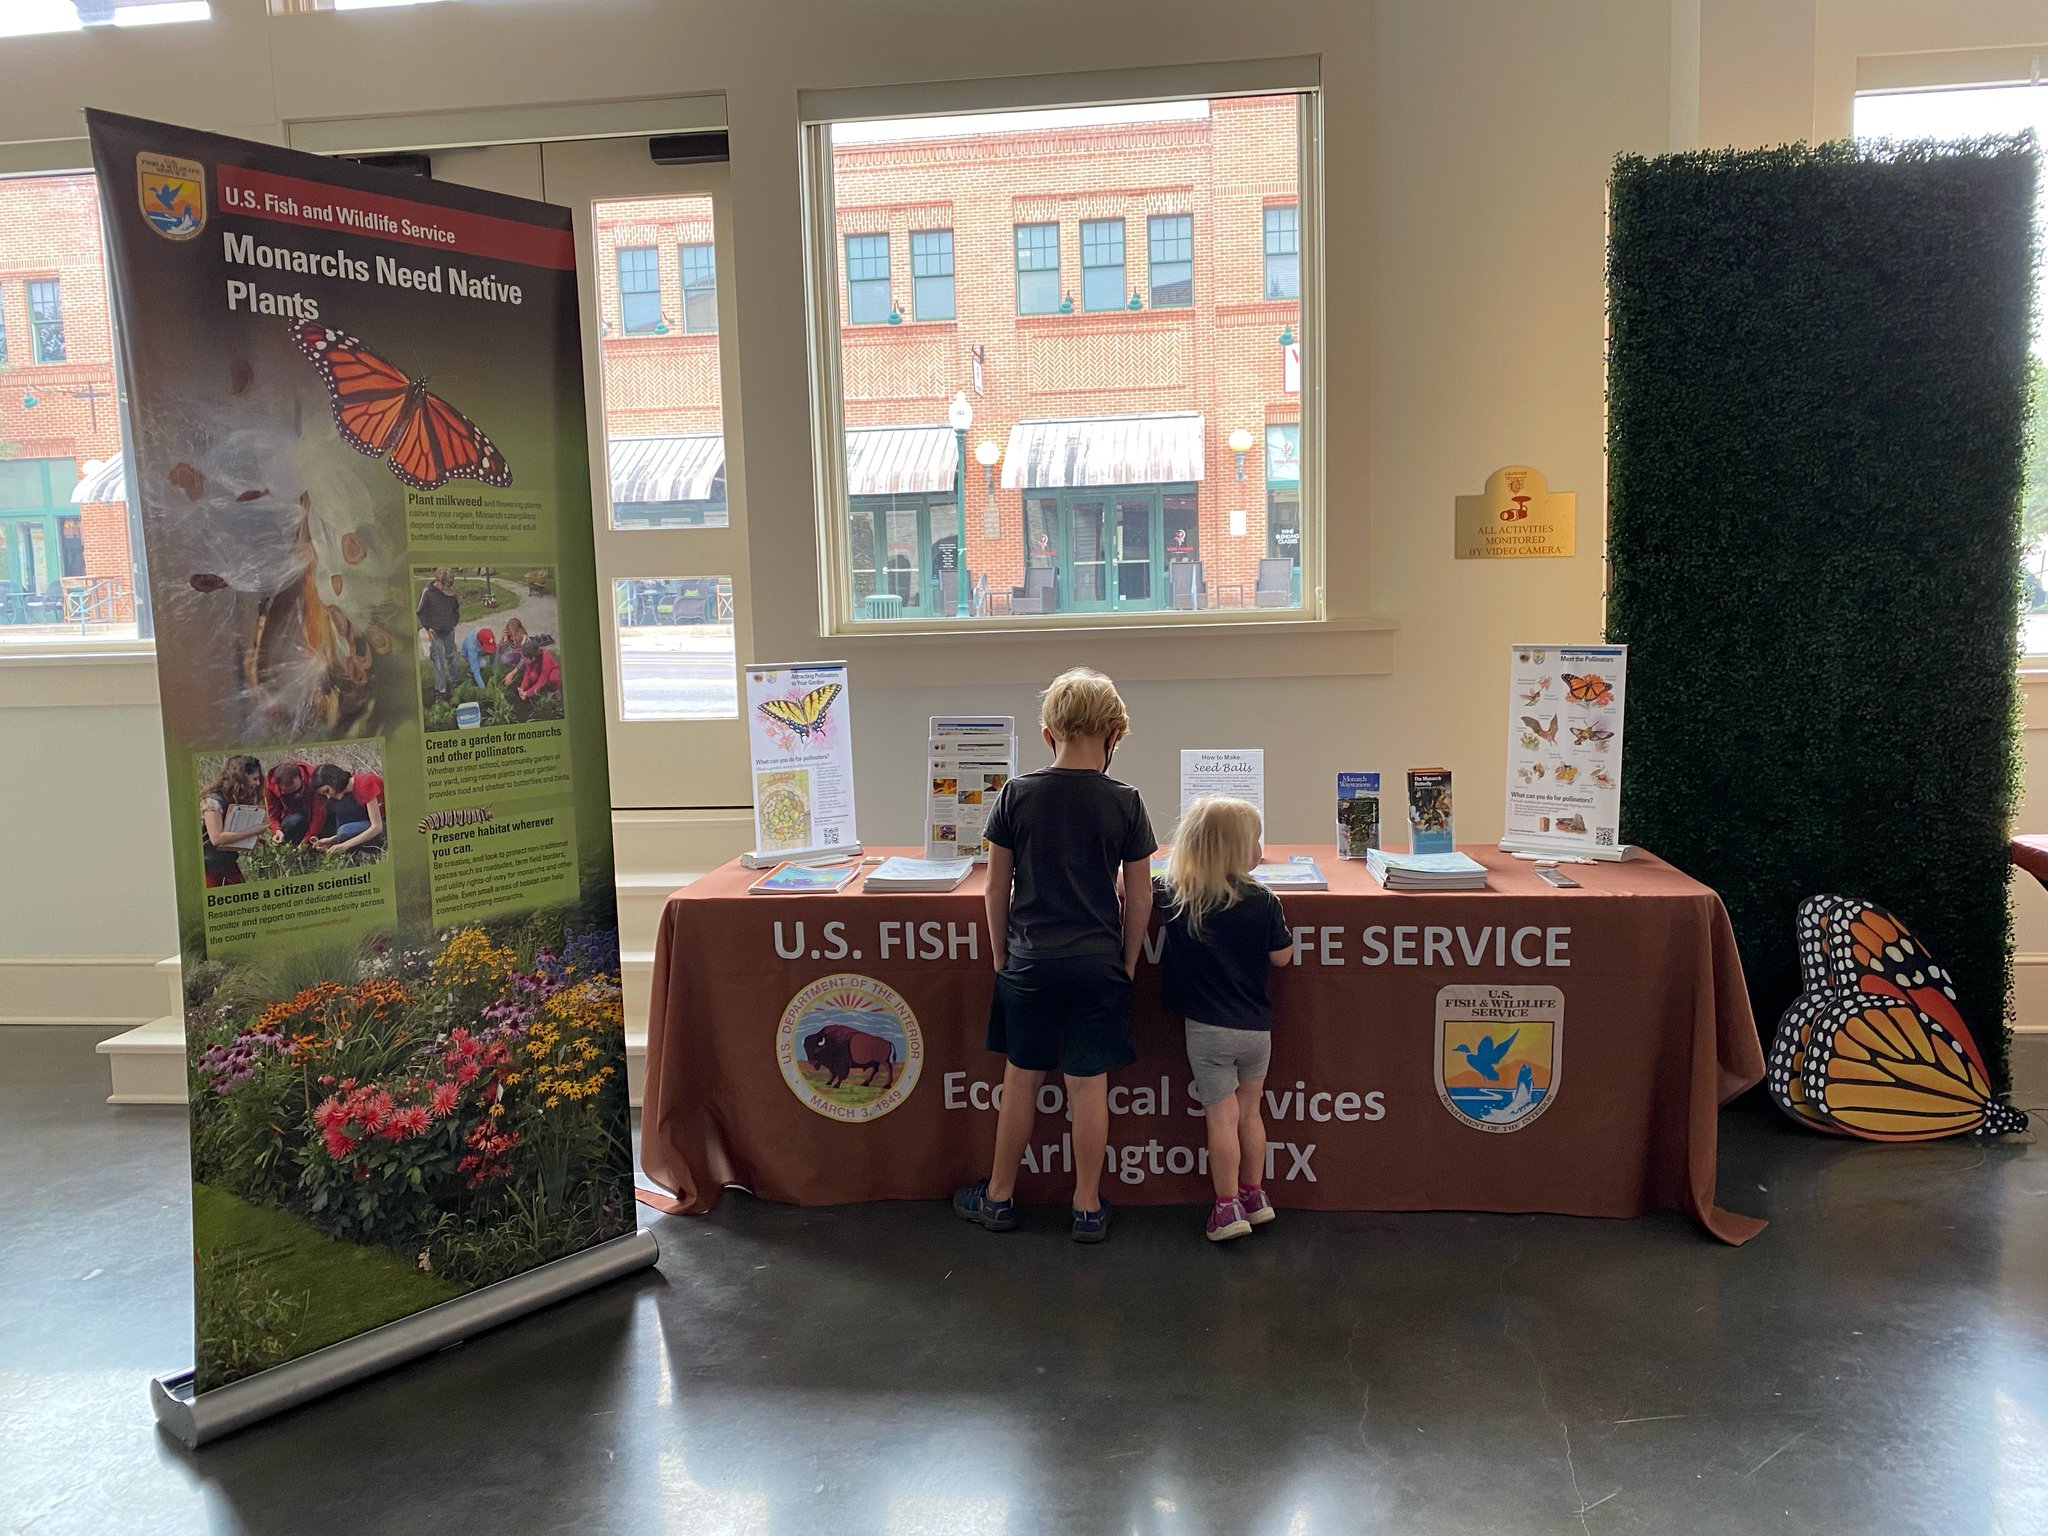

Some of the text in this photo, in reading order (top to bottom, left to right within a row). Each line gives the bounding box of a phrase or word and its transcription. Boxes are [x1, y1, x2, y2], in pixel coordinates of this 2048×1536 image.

[225, 186, 456, 244] U.S. Fish and Wildlife Service
[223, 231, 522, 305] Monarchs Need Native
[227, 279, 319, 320] Plants
[409, 493, 482, 507] Plant milkweed
[1477, 525, 1554, 535] ALL ACTIVITIES
[1486, 536, 1545, 545] MONITORED
[1469, 546, 1561, 556] BY VIDEO CAMERA
[426, 726, 562, 750] Create a garden for monarchs
[427, 745, 527, 764] and other pollinators.
[1193, 763, 1254, 773] Seed Balls
[432, 816, 554, 844] Preserve habitat wherever
[433, 844, 473, 860] you can.
[207, 872, 371, 907] Become a citizen scientist!
[208, 886, 380, 920] Researchers depend on dedicated citizens to
[209, 920, 240, 933] monitor
[242, 918, 257, 927] and
[259, 914, 284, 925] report
[285, 912, 295, 920] on
[297, 906, 331, 918] monarch
[332, 902, 359, 913] activity
[360, 897, 385, 908] across
[210, 935, 222, 945] the
[773, 921, 979, 960] U.S. FISH
[1362, 926, 1572, 966] SERVICE
[1479, 1000, 1488, 1008] &
[1492, 1000, 1556, 1008] WILDLIFE
[1488, 990, 1512, 999] U.S.
[781, 978, 920, 1064] U.S. DEPARTMENT OF THE INTERIOR
[1472, 1009, 1528, 1017] SERVICE
[810, 1095, 855, 1118] MARCH
[877, 1090, 902, 1110] 1849
[1441, 1093, 1485, 1129] DEPARTMENT
[1502, 1122, 1520, 1131] THE
[1523, 1094, 1553, 1125] INTERIOR
[1265, 1142, 1317, 1182] TX
